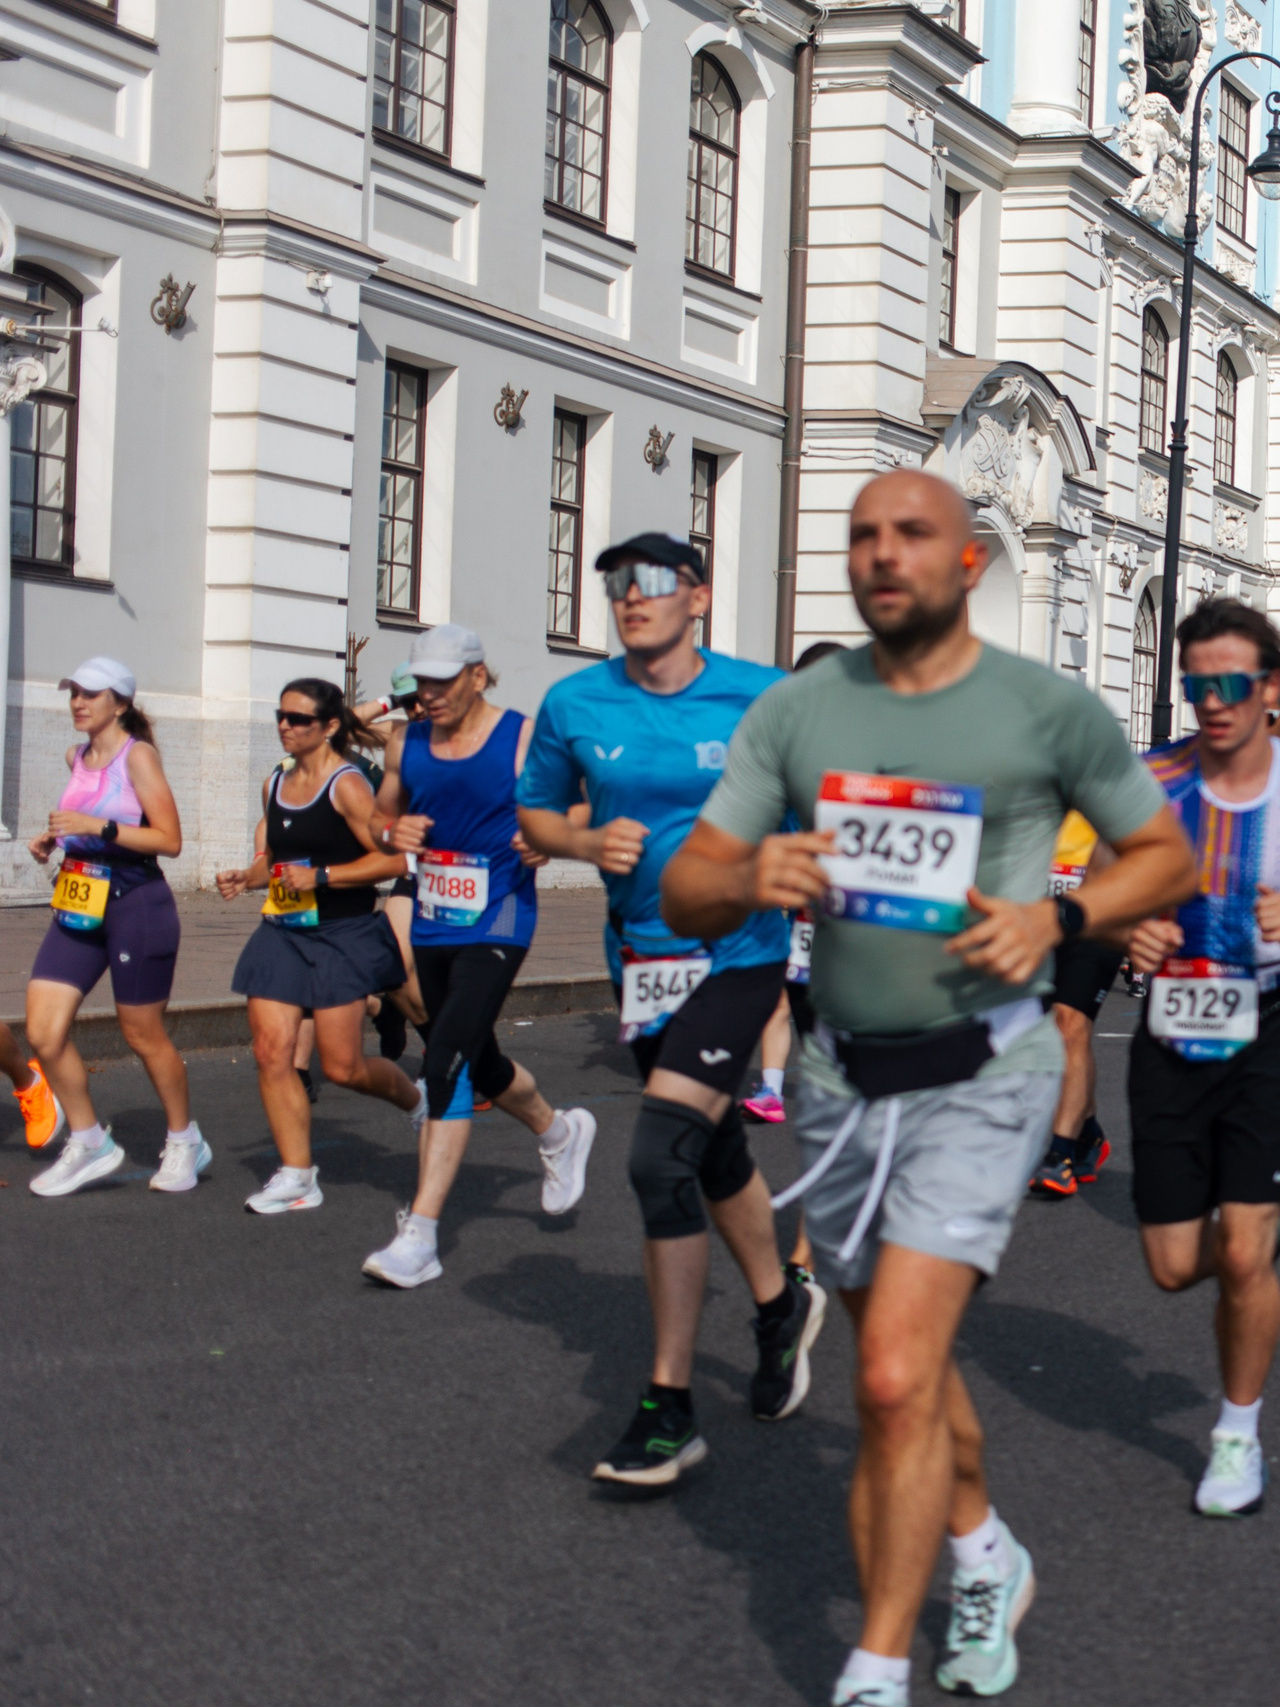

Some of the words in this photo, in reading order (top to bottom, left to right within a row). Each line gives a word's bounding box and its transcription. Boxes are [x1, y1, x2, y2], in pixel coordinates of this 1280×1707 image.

[842, 818, 955, 870] 3439
[62, 878, 91, 902] 183
[424, 872, 476, 900] 7088
[1164, 986, 1242, 1019] 5129
